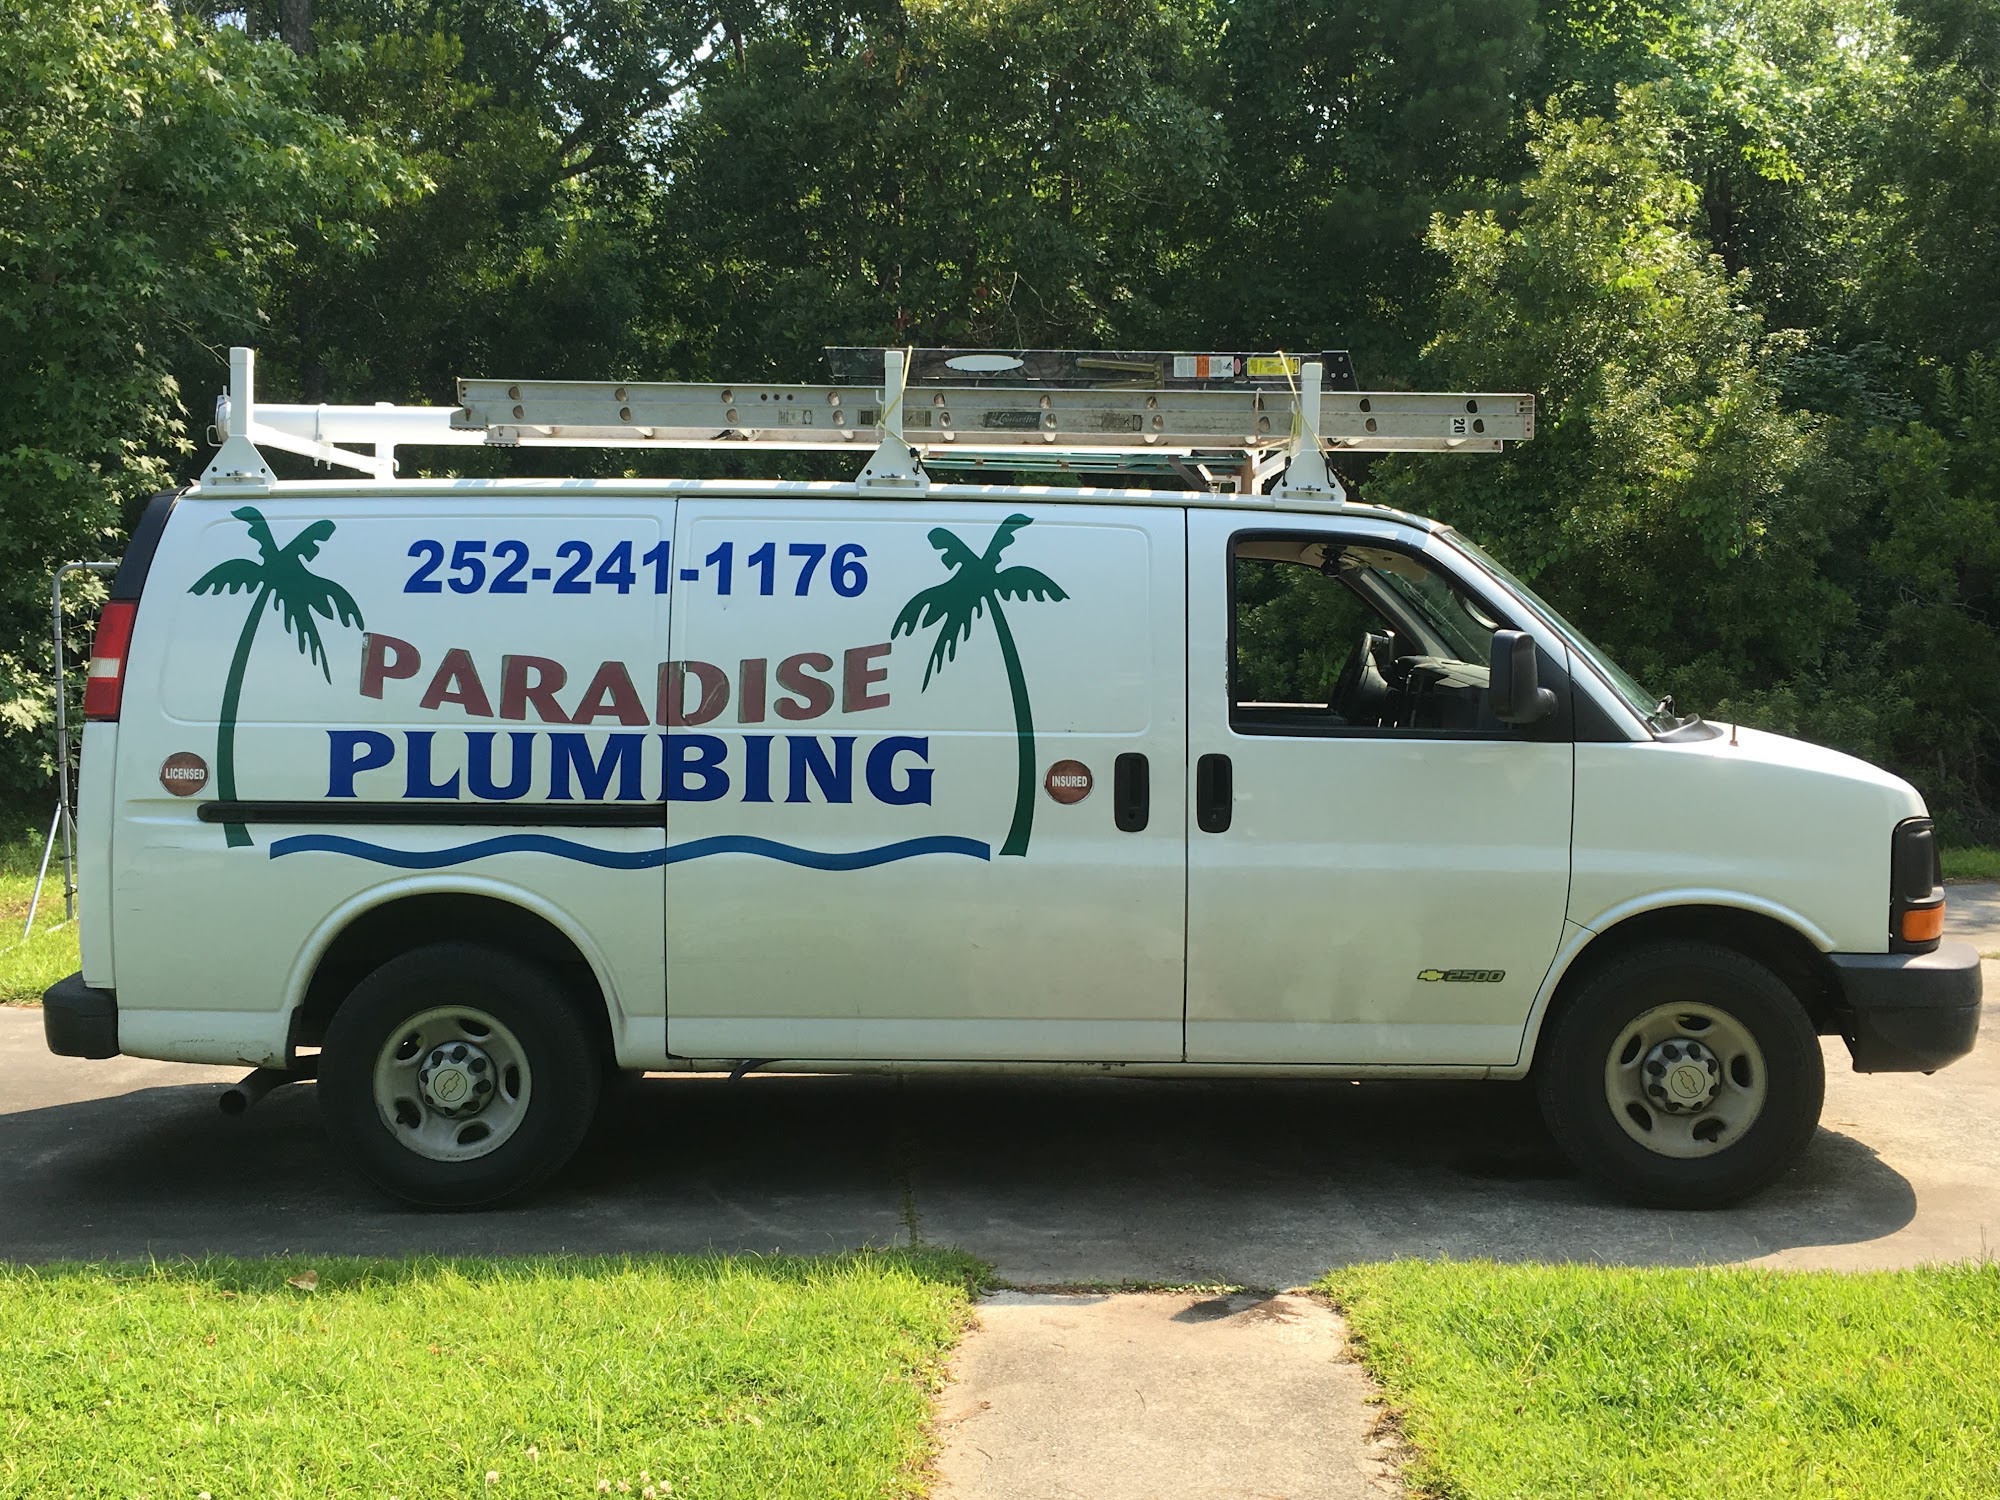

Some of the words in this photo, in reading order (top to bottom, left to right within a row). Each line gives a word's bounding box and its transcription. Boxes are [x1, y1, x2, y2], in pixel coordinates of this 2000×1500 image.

[403, 540, 868, 597] 252-241-1176
[359, 632, 892, 726] PARADISE
[165, 767, 205, 780] LICENSED
[325, 730, 935, 806] PLUMBING
[1051, 775, 1088, 788] INSURED
[1445, 970, 1505, 982] 2500
